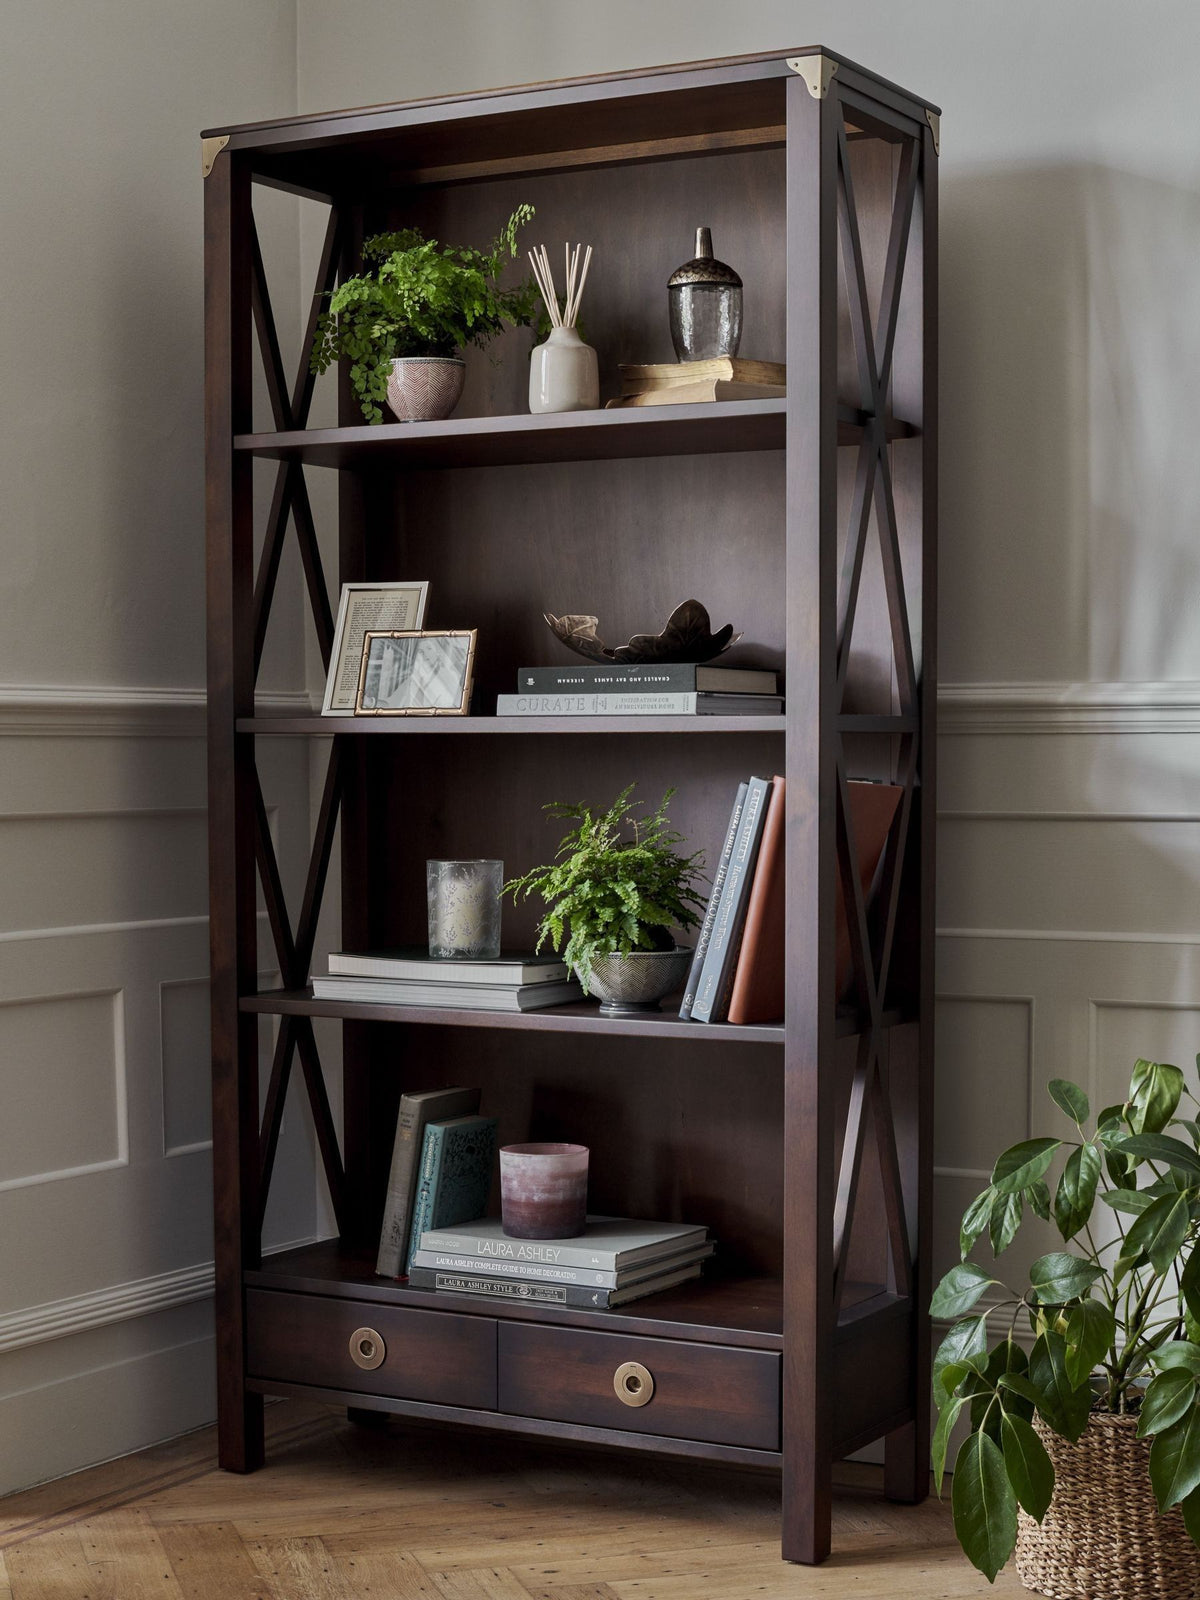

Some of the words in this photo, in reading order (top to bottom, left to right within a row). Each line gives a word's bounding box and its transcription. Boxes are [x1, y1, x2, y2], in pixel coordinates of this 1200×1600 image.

[516, 697, 585, 712] CURATE
[731, 805, 743, 831] LAURA
[748, 788, 761, 822] LAURA
[723, 831, 736, 859] ASHLEY
[738, 823, 753, 863] ASHLEY
[716, 865, 728, 885] THE
[705, 887, 722, 930] COLOUR
[697, 930, 711, 960] BOOK
[477, 1241, 514, 1257] LAURA
[517, 1245, 561, 1263] ASHLEY
[436, 1257, 454, 1266] LAURA
[454, 1259, 474, 1268] ASHLEY
[475, 1261, 501, 1271] COMPLETE
[501, 1263, 519, 1273] GUIDE
[519, 1265, 527, 1274] TO
[526, 1266, 543, 1276] HOME
[543, 1268, 577, 1280] DECORATING
[443, 1278, 466, 1288] LAURA
[467, 1280, 492, 1291] ASHLEY
[493, 1283, 513, 1293] STYLE
